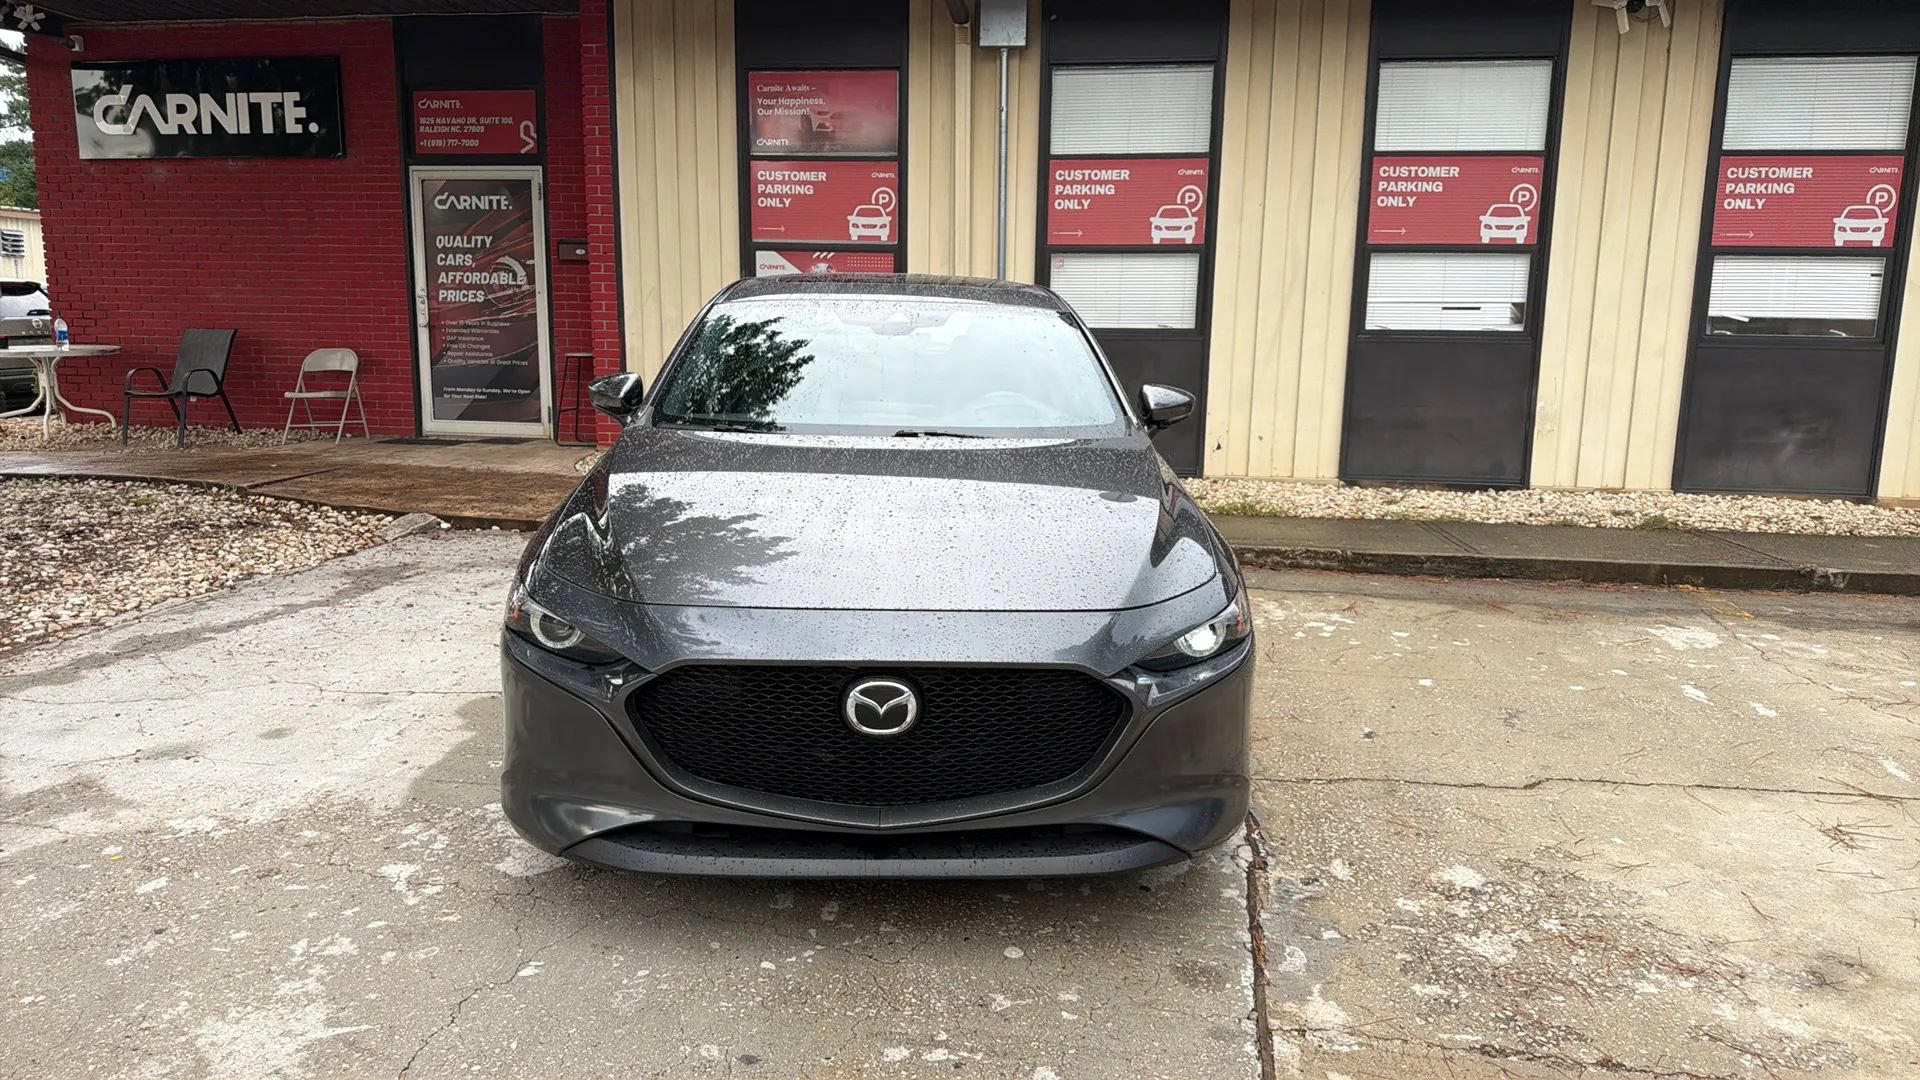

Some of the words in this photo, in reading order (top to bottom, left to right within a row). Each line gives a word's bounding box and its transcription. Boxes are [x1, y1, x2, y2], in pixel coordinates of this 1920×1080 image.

[756, 84, 784, 92] Carnite
[785, 84, 810, 93] Awaits
[418, 98, 463, 109] CARNITE.
[757, 97, 777, 106] Your
[93, 84, 319, 135] CARNITE.
[757, 107, 773, 116] Our
[774, 107, 810, 116] Mission!
[435, 117, 466, 125] NAVAHO
[479, 117, 500, 125] SUITE
[419, 125, 450, 133] RALEIGH
[756, 137, 791, 146] CARNITE.
[757, 170, 827, 182] CUSTOMER
[1055, 169, 1130, 181] CUSTOMER
[1379, 166, 1460, 178] CUSTOMER
[1727, 167, 1813, 179] CUSTOMER
[757, 184, 814, 195] PARKING
[1055, 184, 1115, 195] PARKING
[1378, 181, 1443, 192] PARKING
[1725, 182, 1795, 194] PARKING
[434, 192, 512, 210] CARNITE.
[757, 197, 792, 208] ONLY
[1054, 199, 1091, 210] ONLY
[1376, 196, 1417, 207] ONLY
[1723, 198, 1766, 210] ONLY
[435, 235, 493, 248] QUALITY
[437, 253, 476, 268] CARS,
[438, 271, 527, 285] AFFORDABLE
[466, 343, 491, 351] Changes
